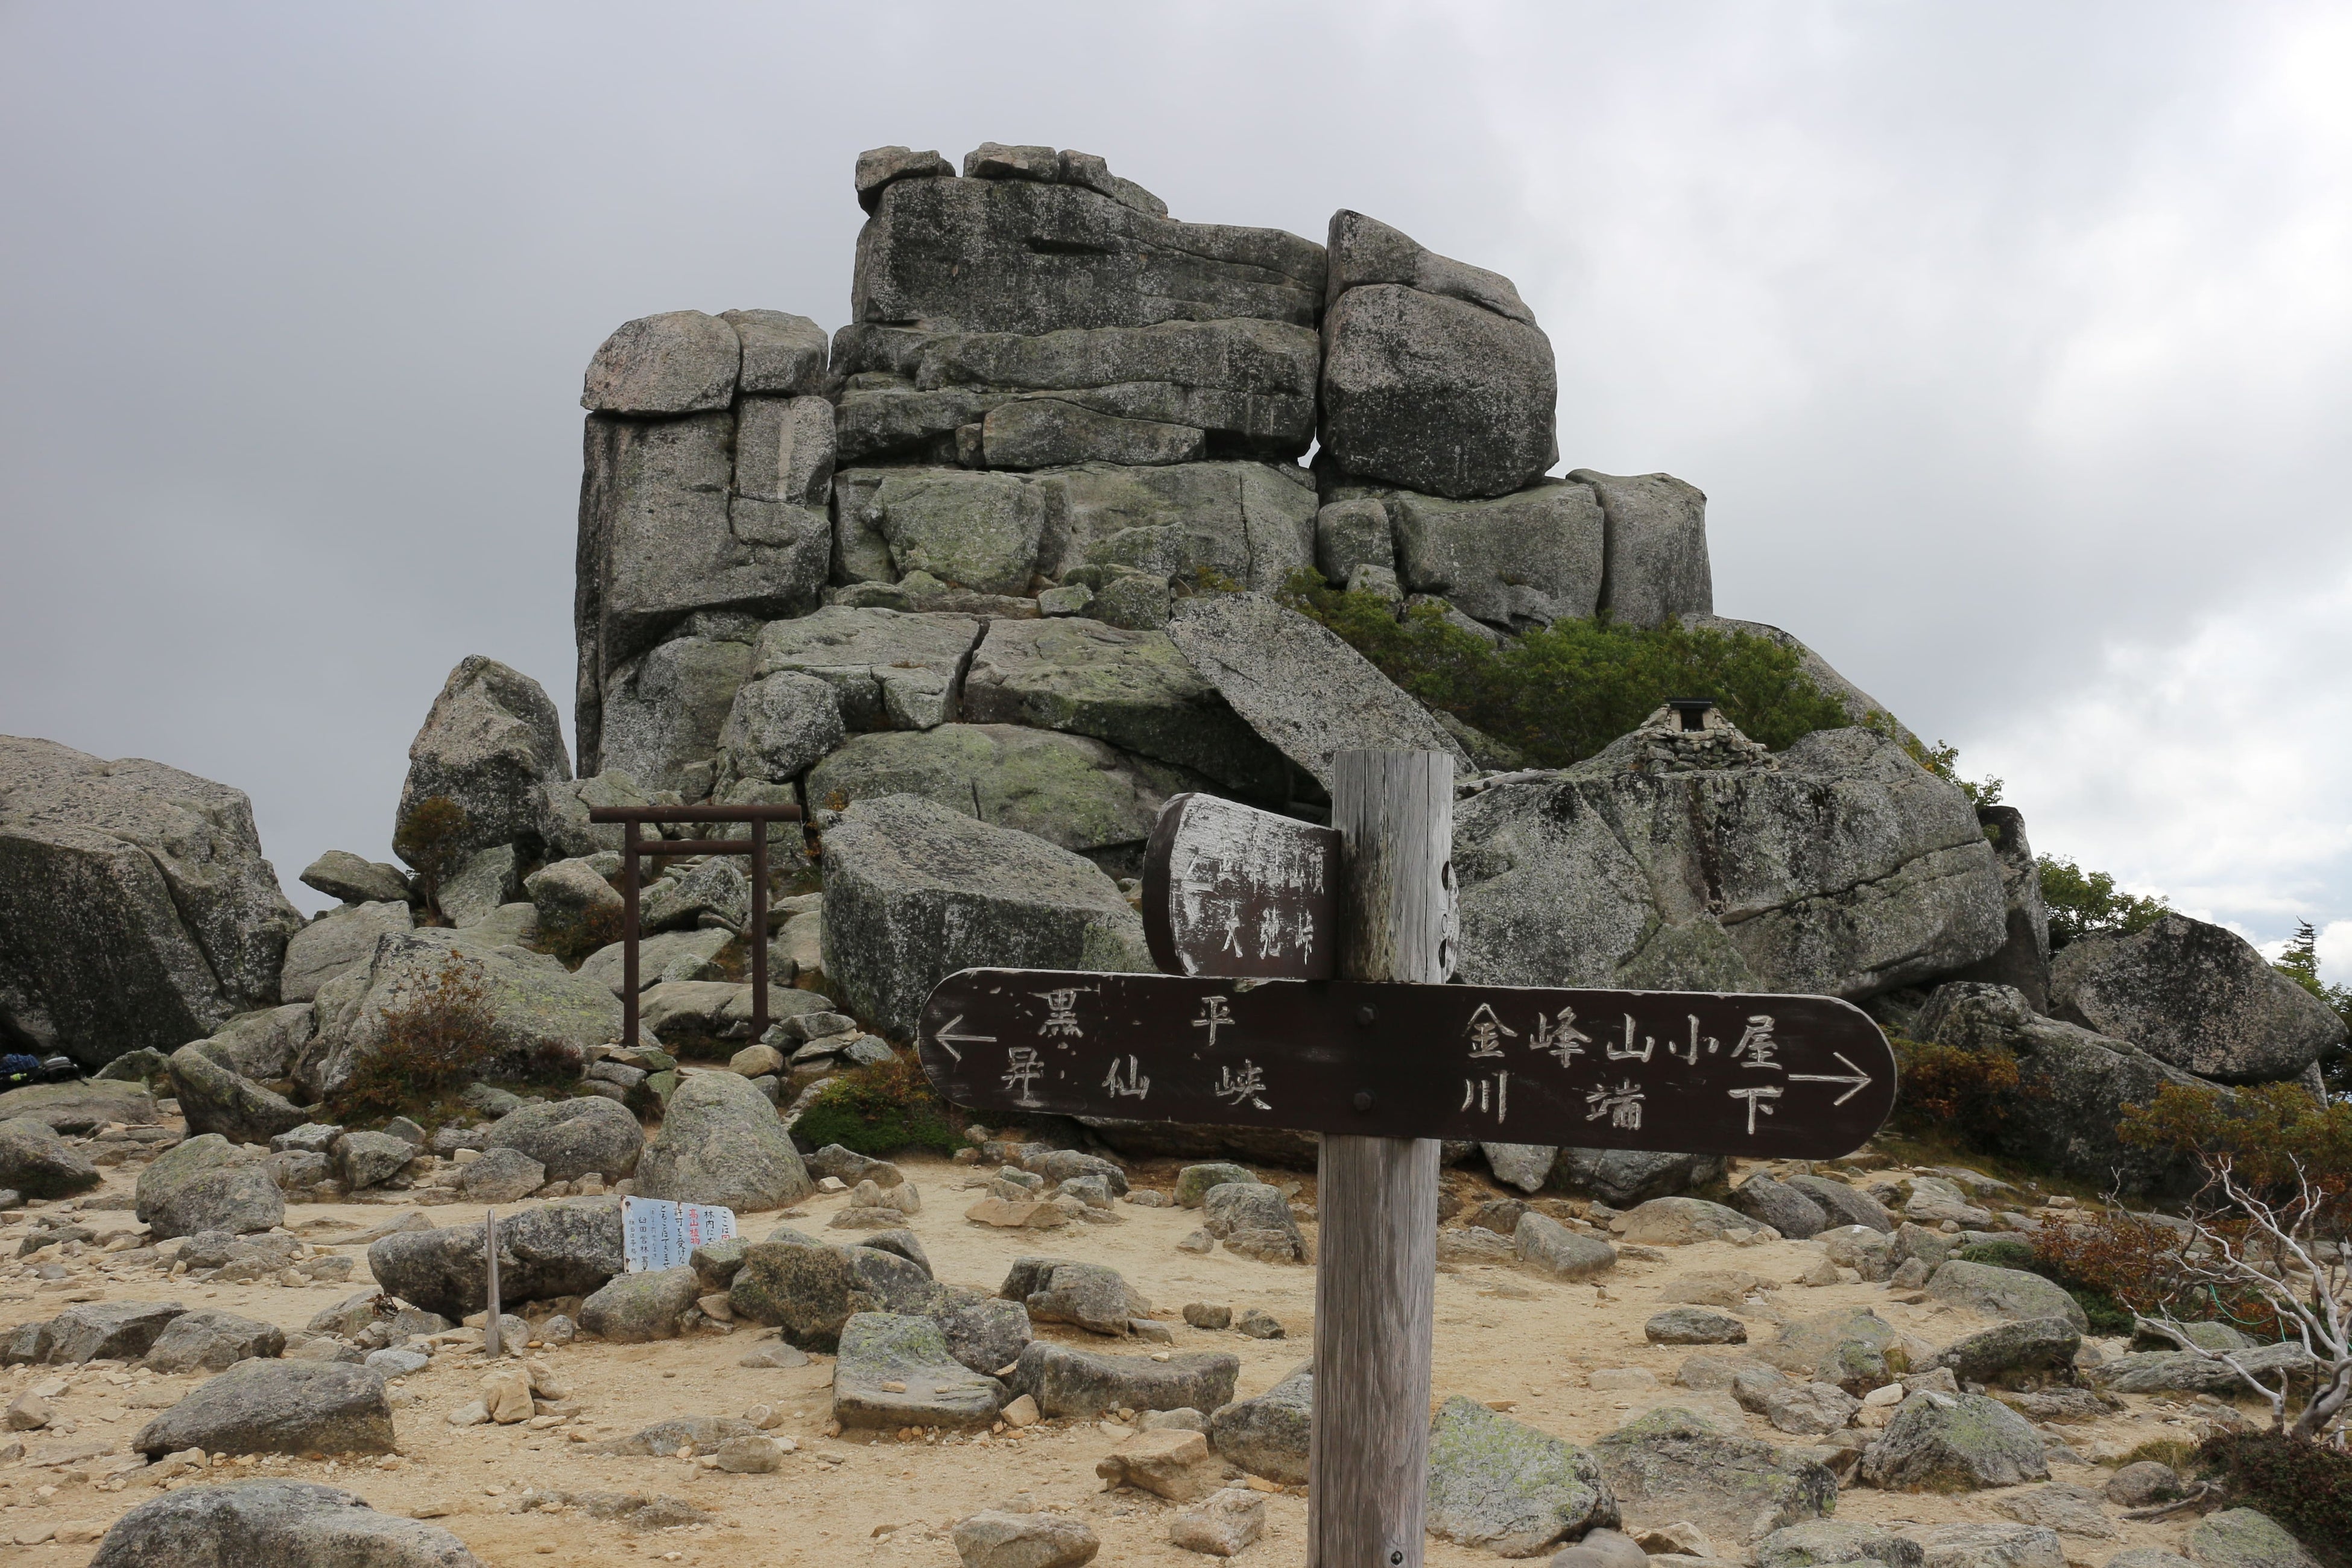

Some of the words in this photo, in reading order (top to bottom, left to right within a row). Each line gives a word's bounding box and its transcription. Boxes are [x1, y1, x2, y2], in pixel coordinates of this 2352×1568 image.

[1037, 988, 1235, 1046] 黒平
[1462, 1002, 1783, 1070] 金峰山小屋
[1001, 1047, 1271, 1110] 昇仙峡
[1461, 1070, 1785, 1135] 川端下
[660, 1205, 671, 1269] とることはできませ
[673, 1207, 685, 1266] 許可を受けな
[689, 1208, 700, 1245] 高山植物
